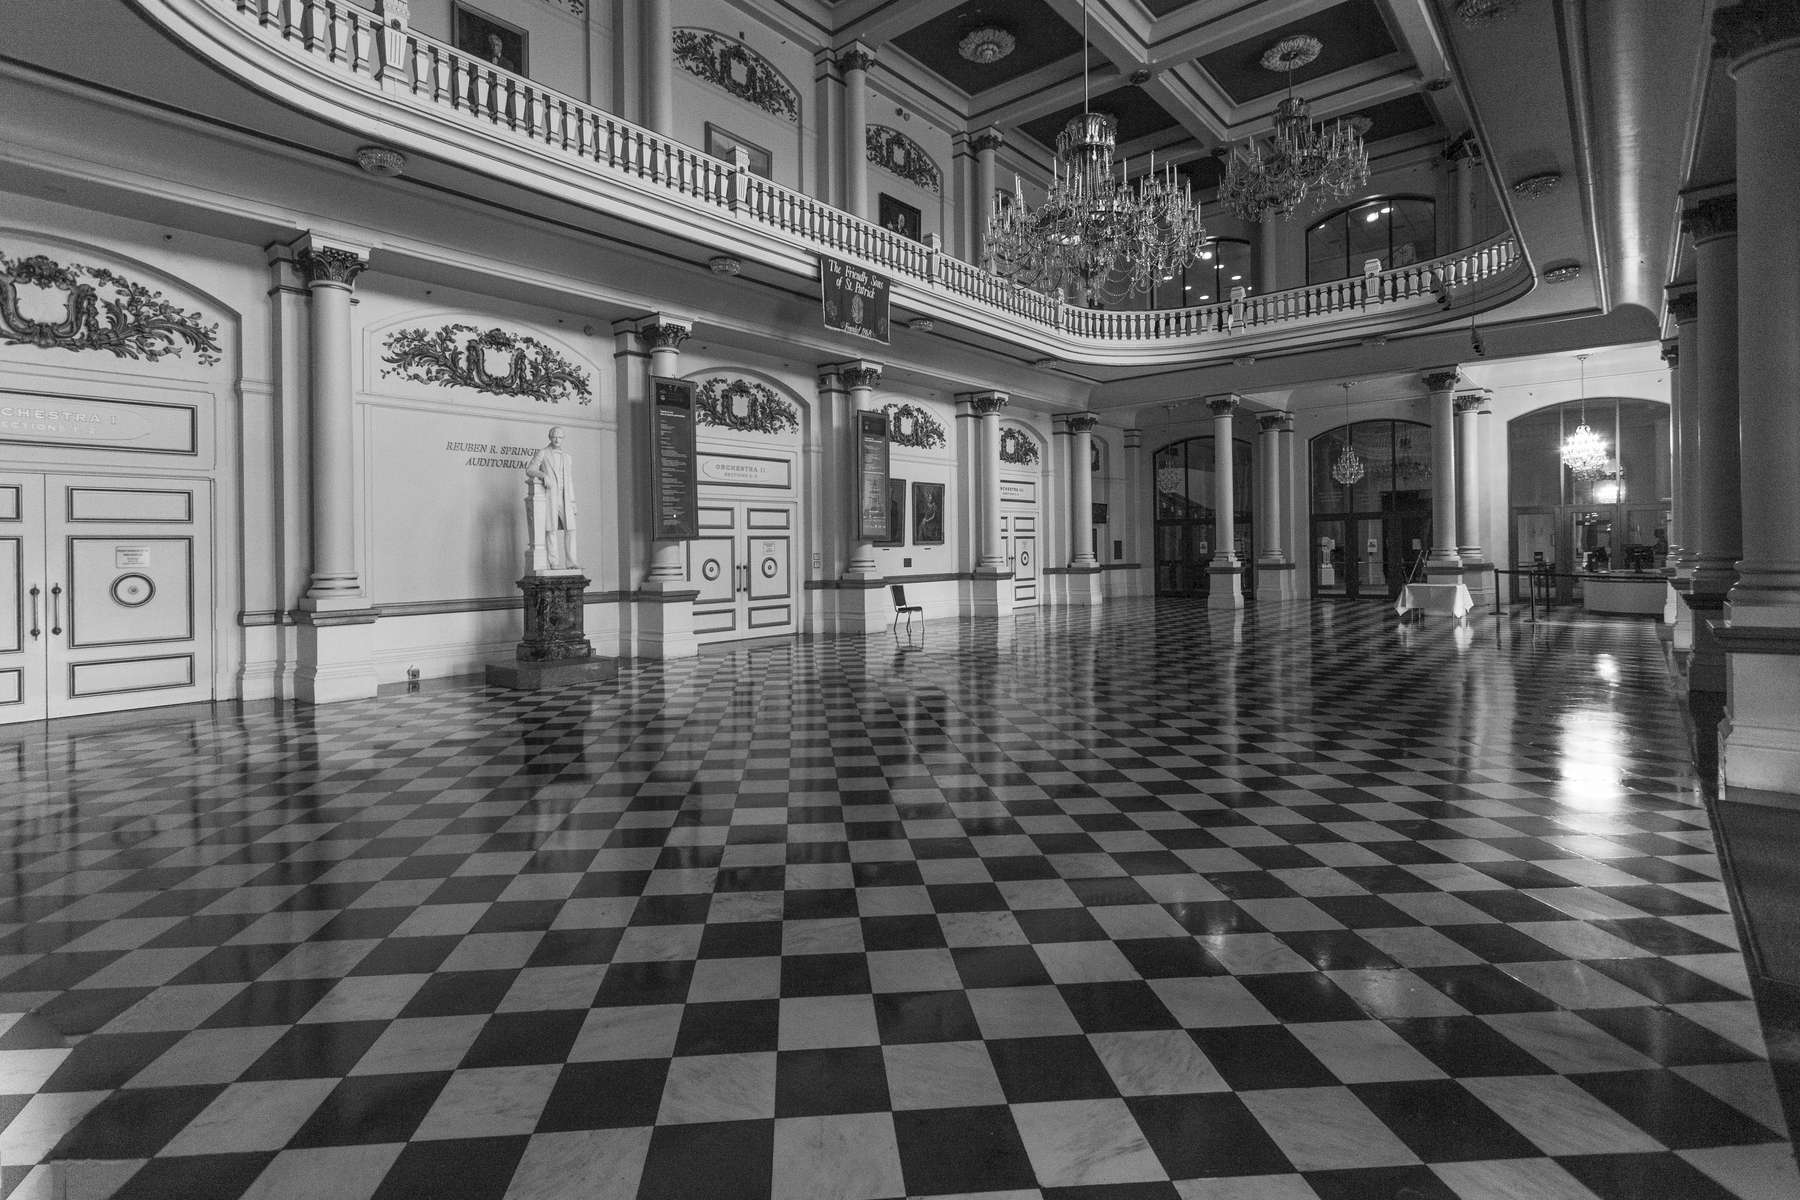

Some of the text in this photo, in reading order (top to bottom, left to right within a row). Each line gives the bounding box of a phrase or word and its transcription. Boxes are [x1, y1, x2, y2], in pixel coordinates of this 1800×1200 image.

[829, 259, 884, 289] The Friendly Sons
[835, 276, 843, 289] of
[855, 281, 875, 299] Patrick
[446, 441, 487, 453] REUBEN
[490, 445, 498, 454] R.
[465, 457, 527, 469] AUDITORIUM
[715, 464, 757, 473] ORCHESTRA
